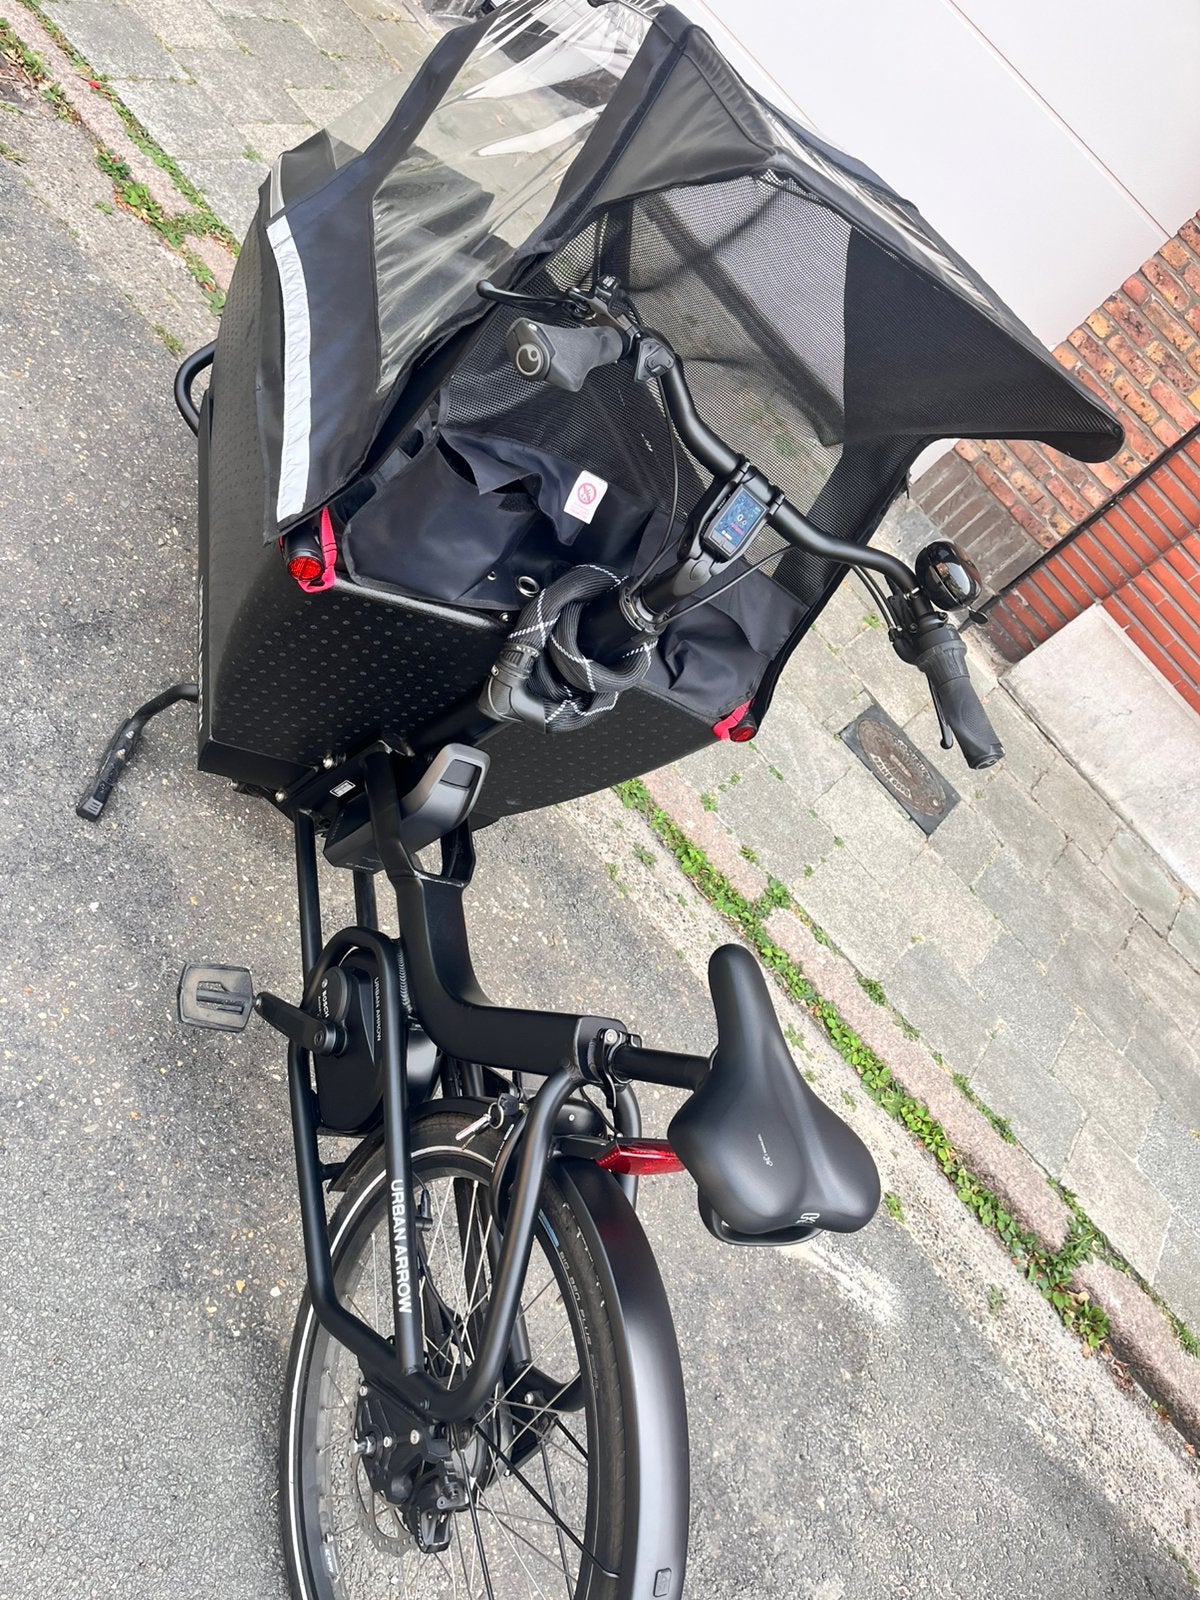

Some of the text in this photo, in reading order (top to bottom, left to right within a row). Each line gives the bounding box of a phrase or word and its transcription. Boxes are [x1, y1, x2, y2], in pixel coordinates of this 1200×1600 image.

[322, 989, 330, 1018] BOSCH
[391, 1179, 412, 1313] URBAN ARROW
